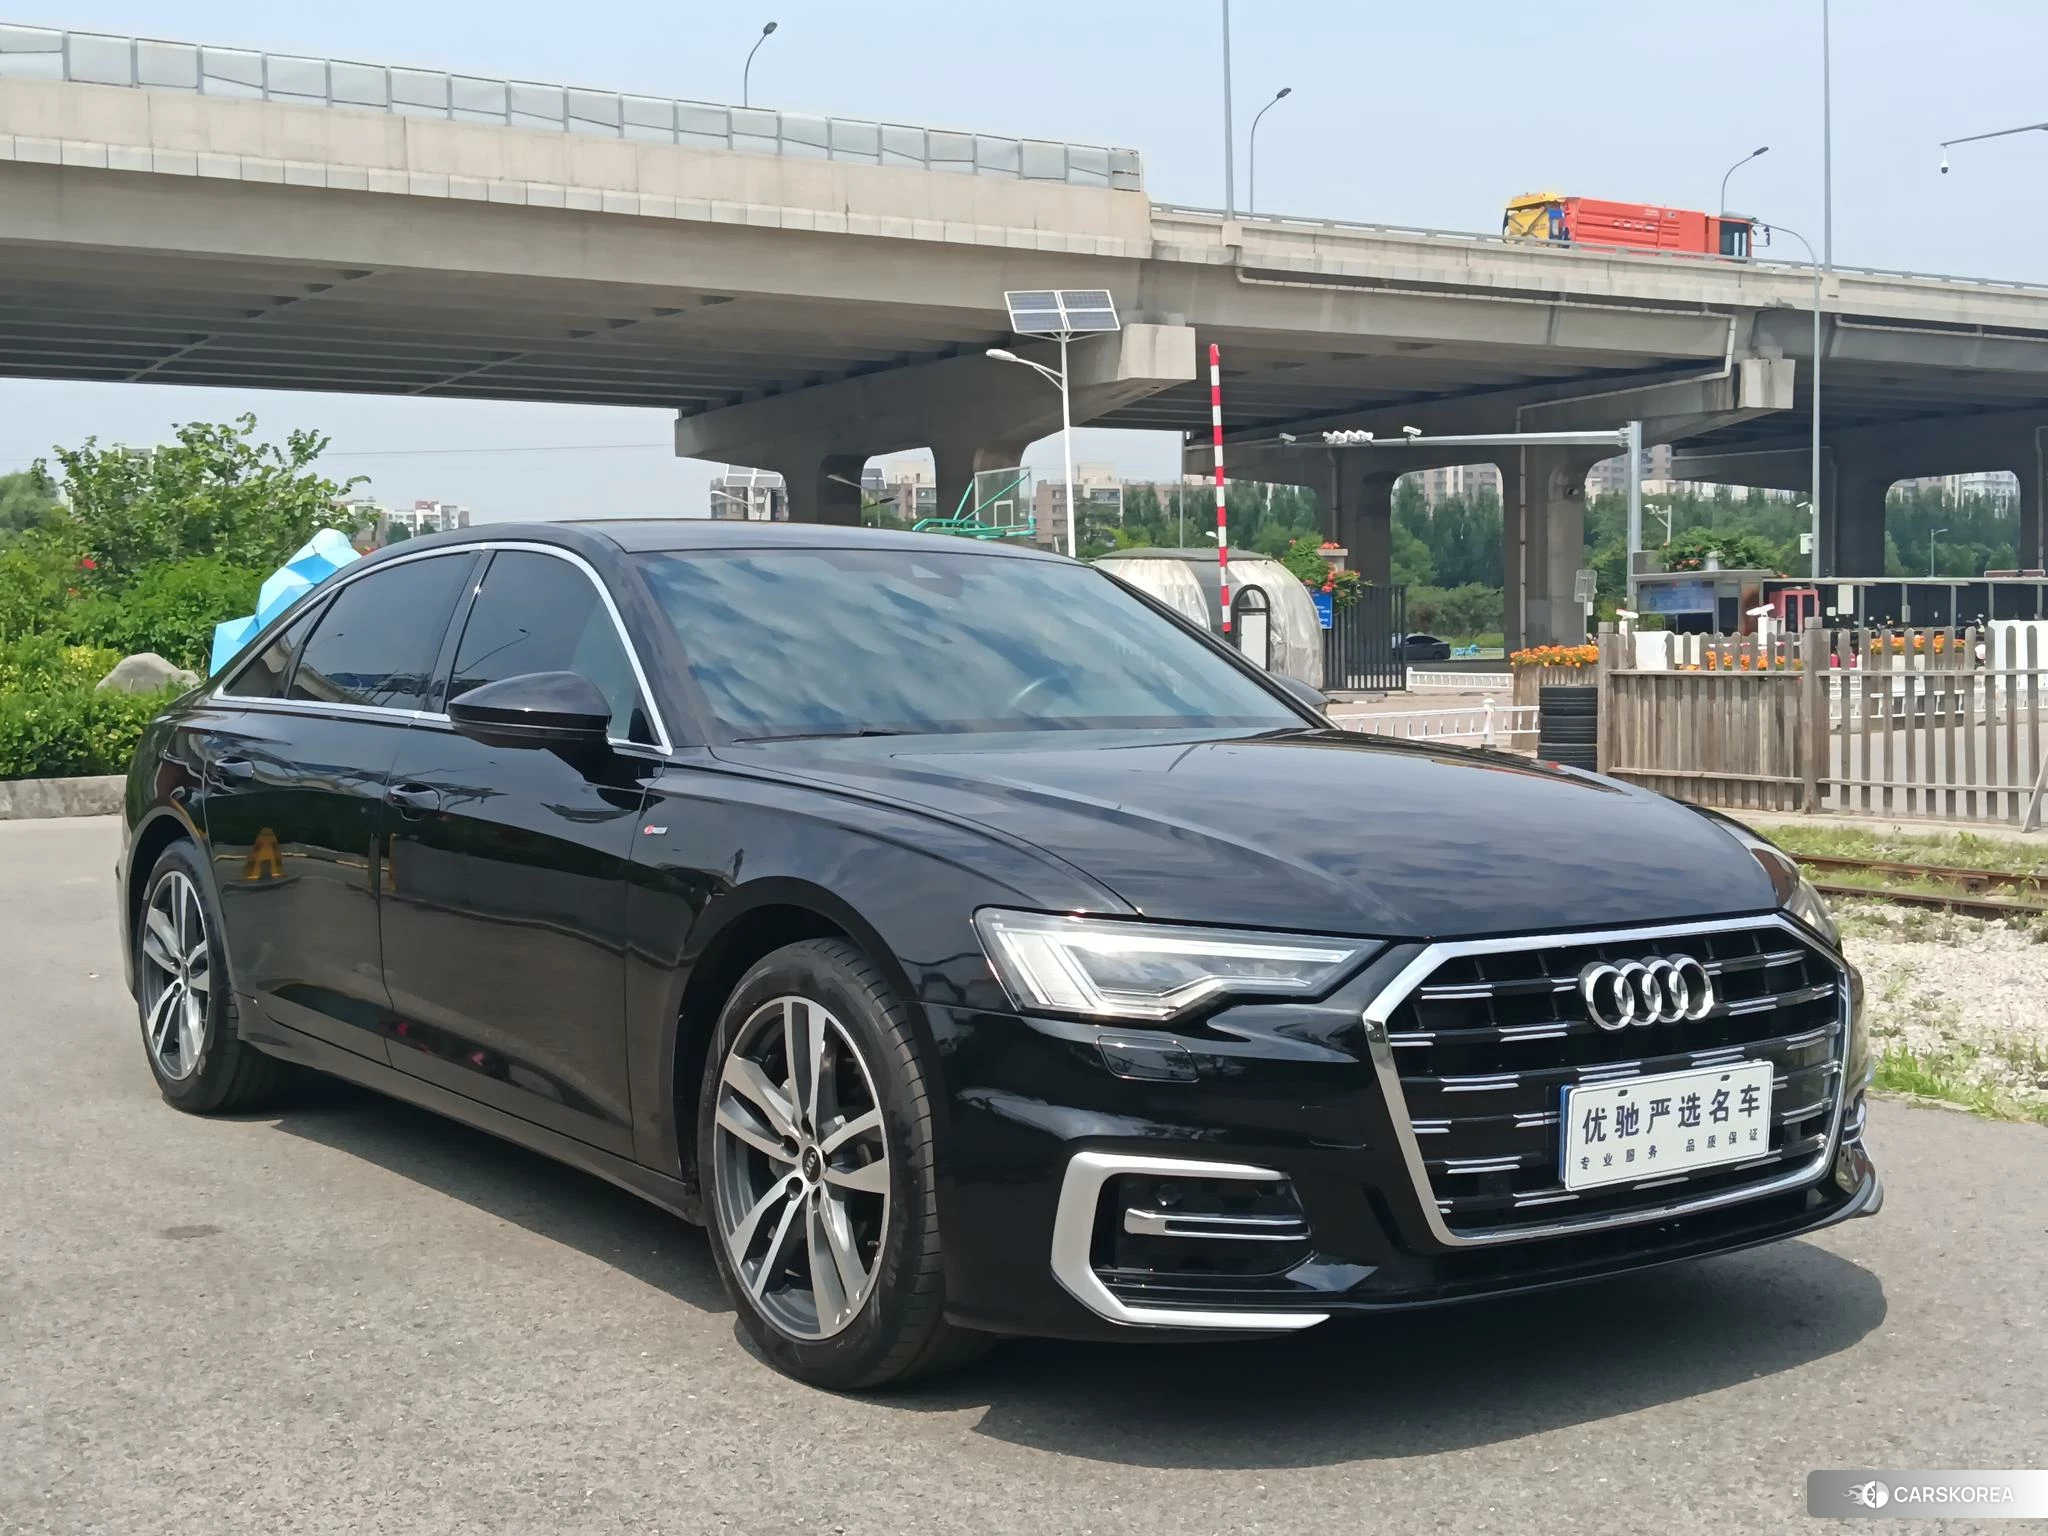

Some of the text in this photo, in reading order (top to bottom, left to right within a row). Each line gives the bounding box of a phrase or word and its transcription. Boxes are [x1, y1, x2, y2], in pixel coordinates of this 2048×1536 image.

[1582, 1084, 1761, 1145] 优驰严选名车
